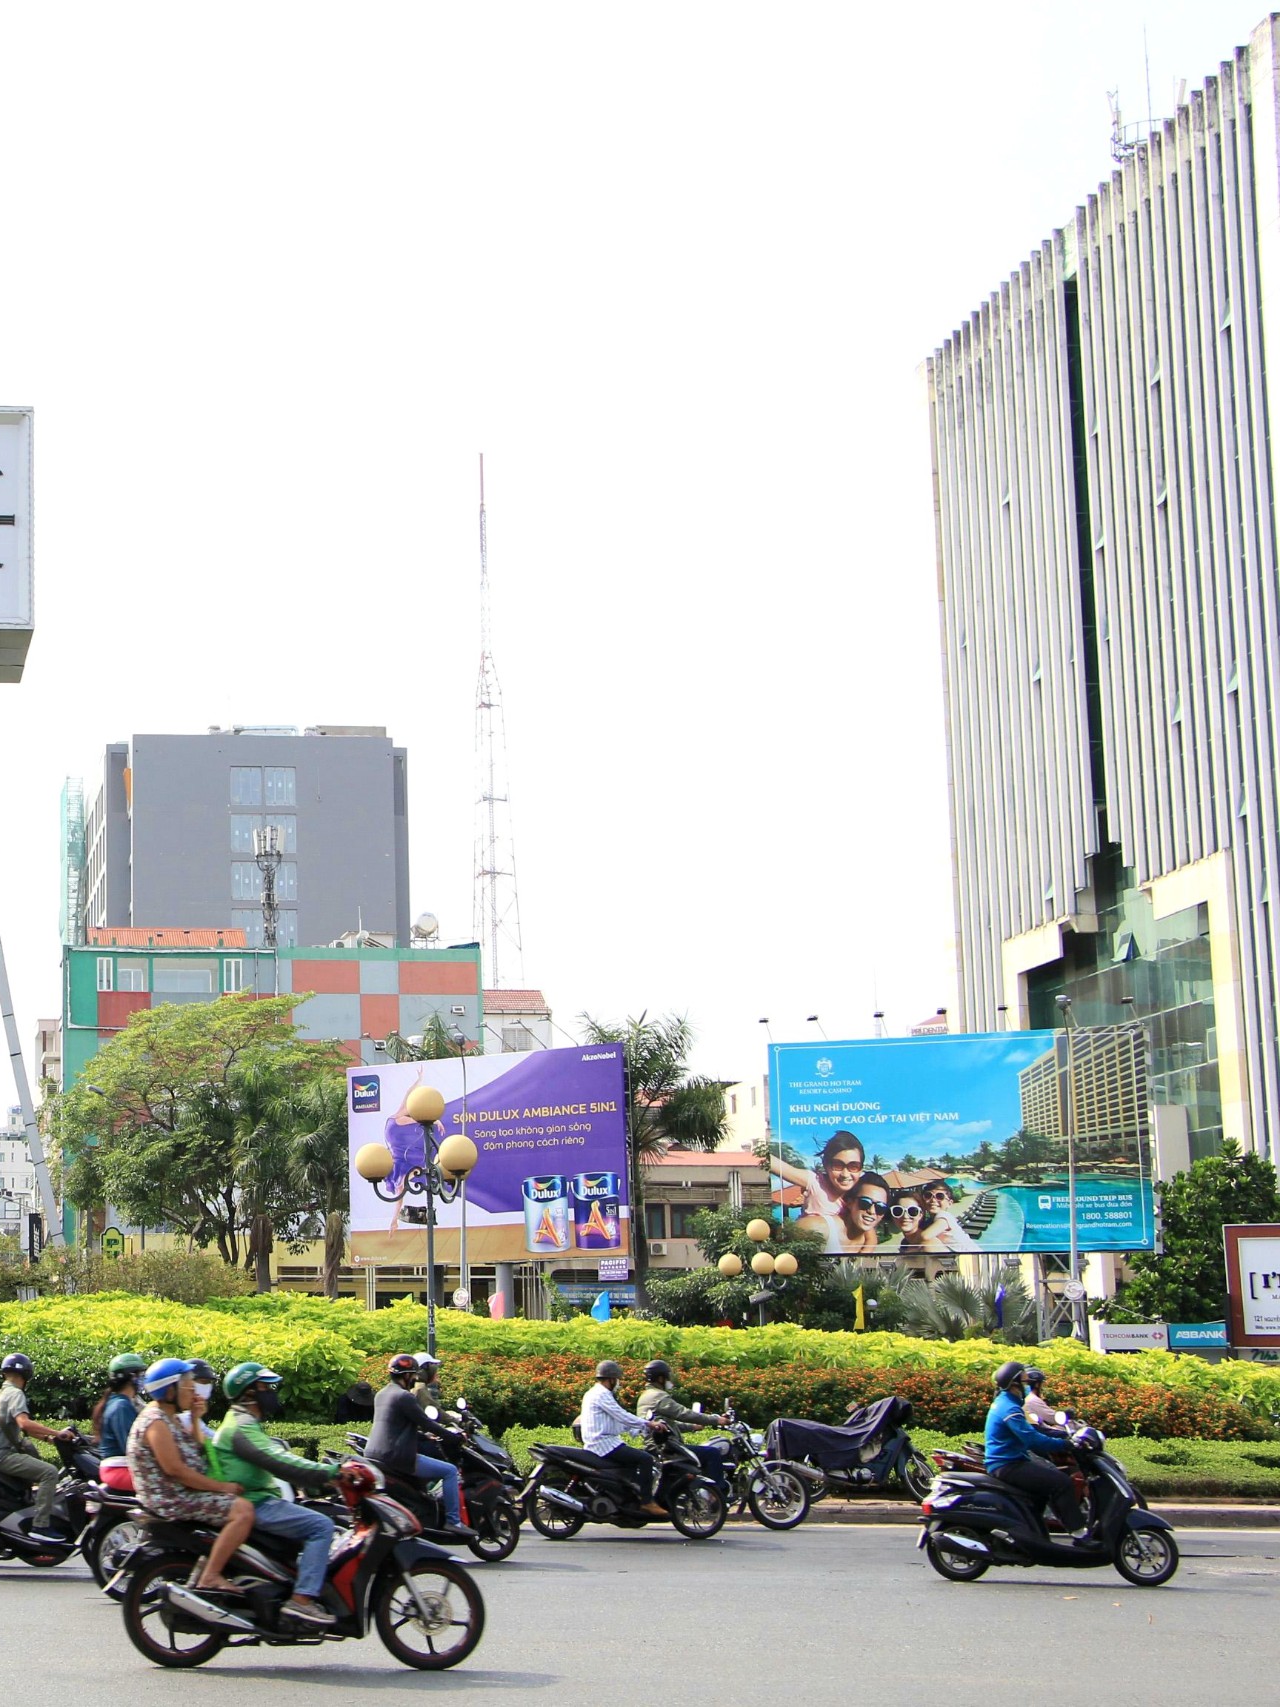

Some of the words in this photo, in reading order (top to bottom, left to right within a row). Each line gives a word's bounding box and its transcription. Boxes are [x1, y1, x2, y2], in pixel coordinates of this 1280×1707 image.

[582, 1051, 616, 1062] AkzoNobel
[354, 1090, 376, 1098] Dulux
[479, 1109, 519, 1122] DULUX
[523, 1103, 586, 1118] AMBIANCE
[589, 1101, 617, 1113] 5IN1
[789, 1104, 811, 1113] KHU
[844, 1115, 866, 1124] CAO
[934, 1112, 959, 1121] NAM
[546, 1124, 567, 1134] gian
[531, 1189, 559, 1199] Dulux
[581, 1186, 609, 1196] Dulux
[1082, 1212, 1102, 1220] 1800.
[1104, 1211, 1132, 1219] 588801
[1175, 1330, 1224, 1339] ABBANK
